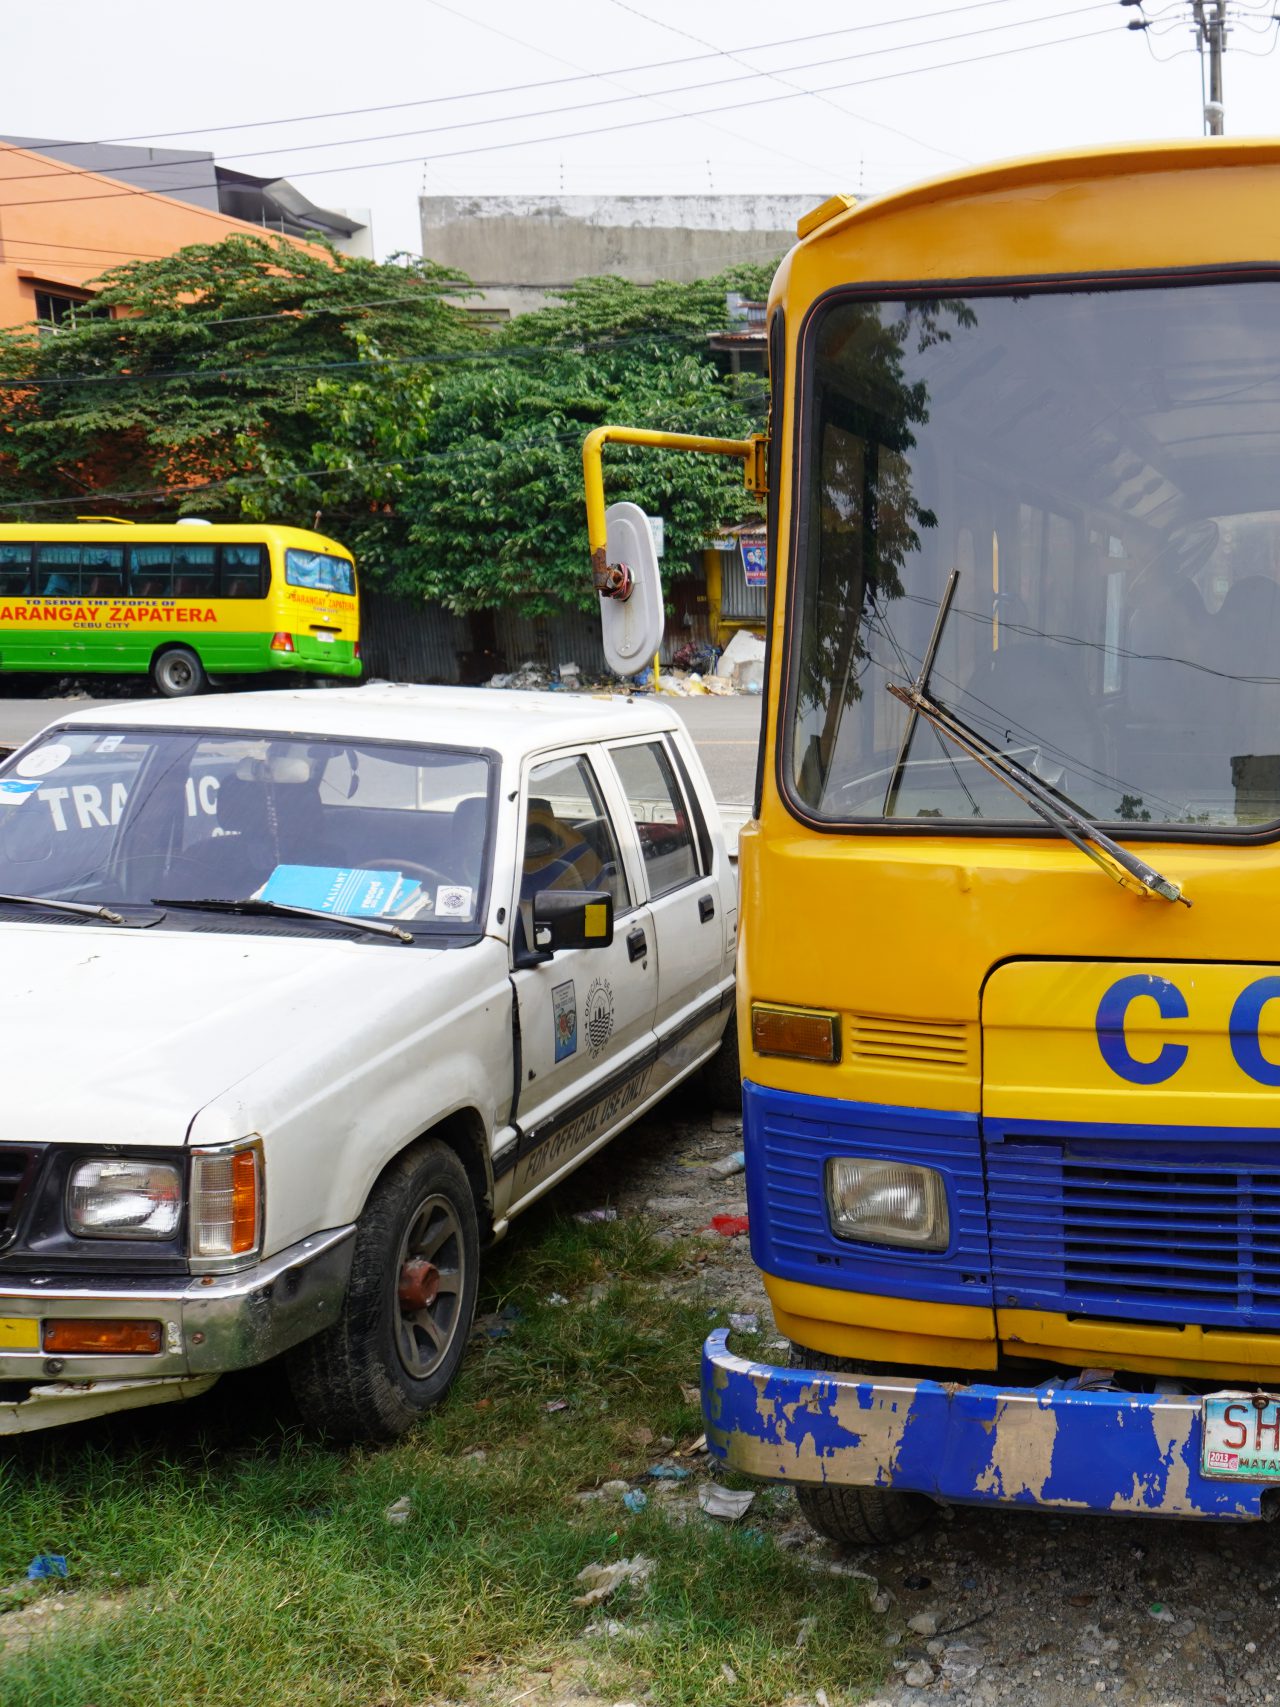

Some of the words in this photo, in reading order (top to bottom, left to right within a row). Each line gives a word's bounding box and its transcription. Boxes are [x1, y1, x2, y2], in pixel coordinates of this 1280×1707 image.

[110, 608, 218, 622] ZAPATERA
[38, 776, 221, 832] TRAIC
[321, 872, 348, 908] VALIANT
[585, 976, 602, 1016] OFFICIAL
[523, 1141, 551, 1184] FOR
[549, 1105, 600, 1161] OFFICIAL
[600, 1088, 624, 1125] USE
[621, 1063, 654, 1109] ONLY
[1210, 1452, 1229, 1463] 2013
